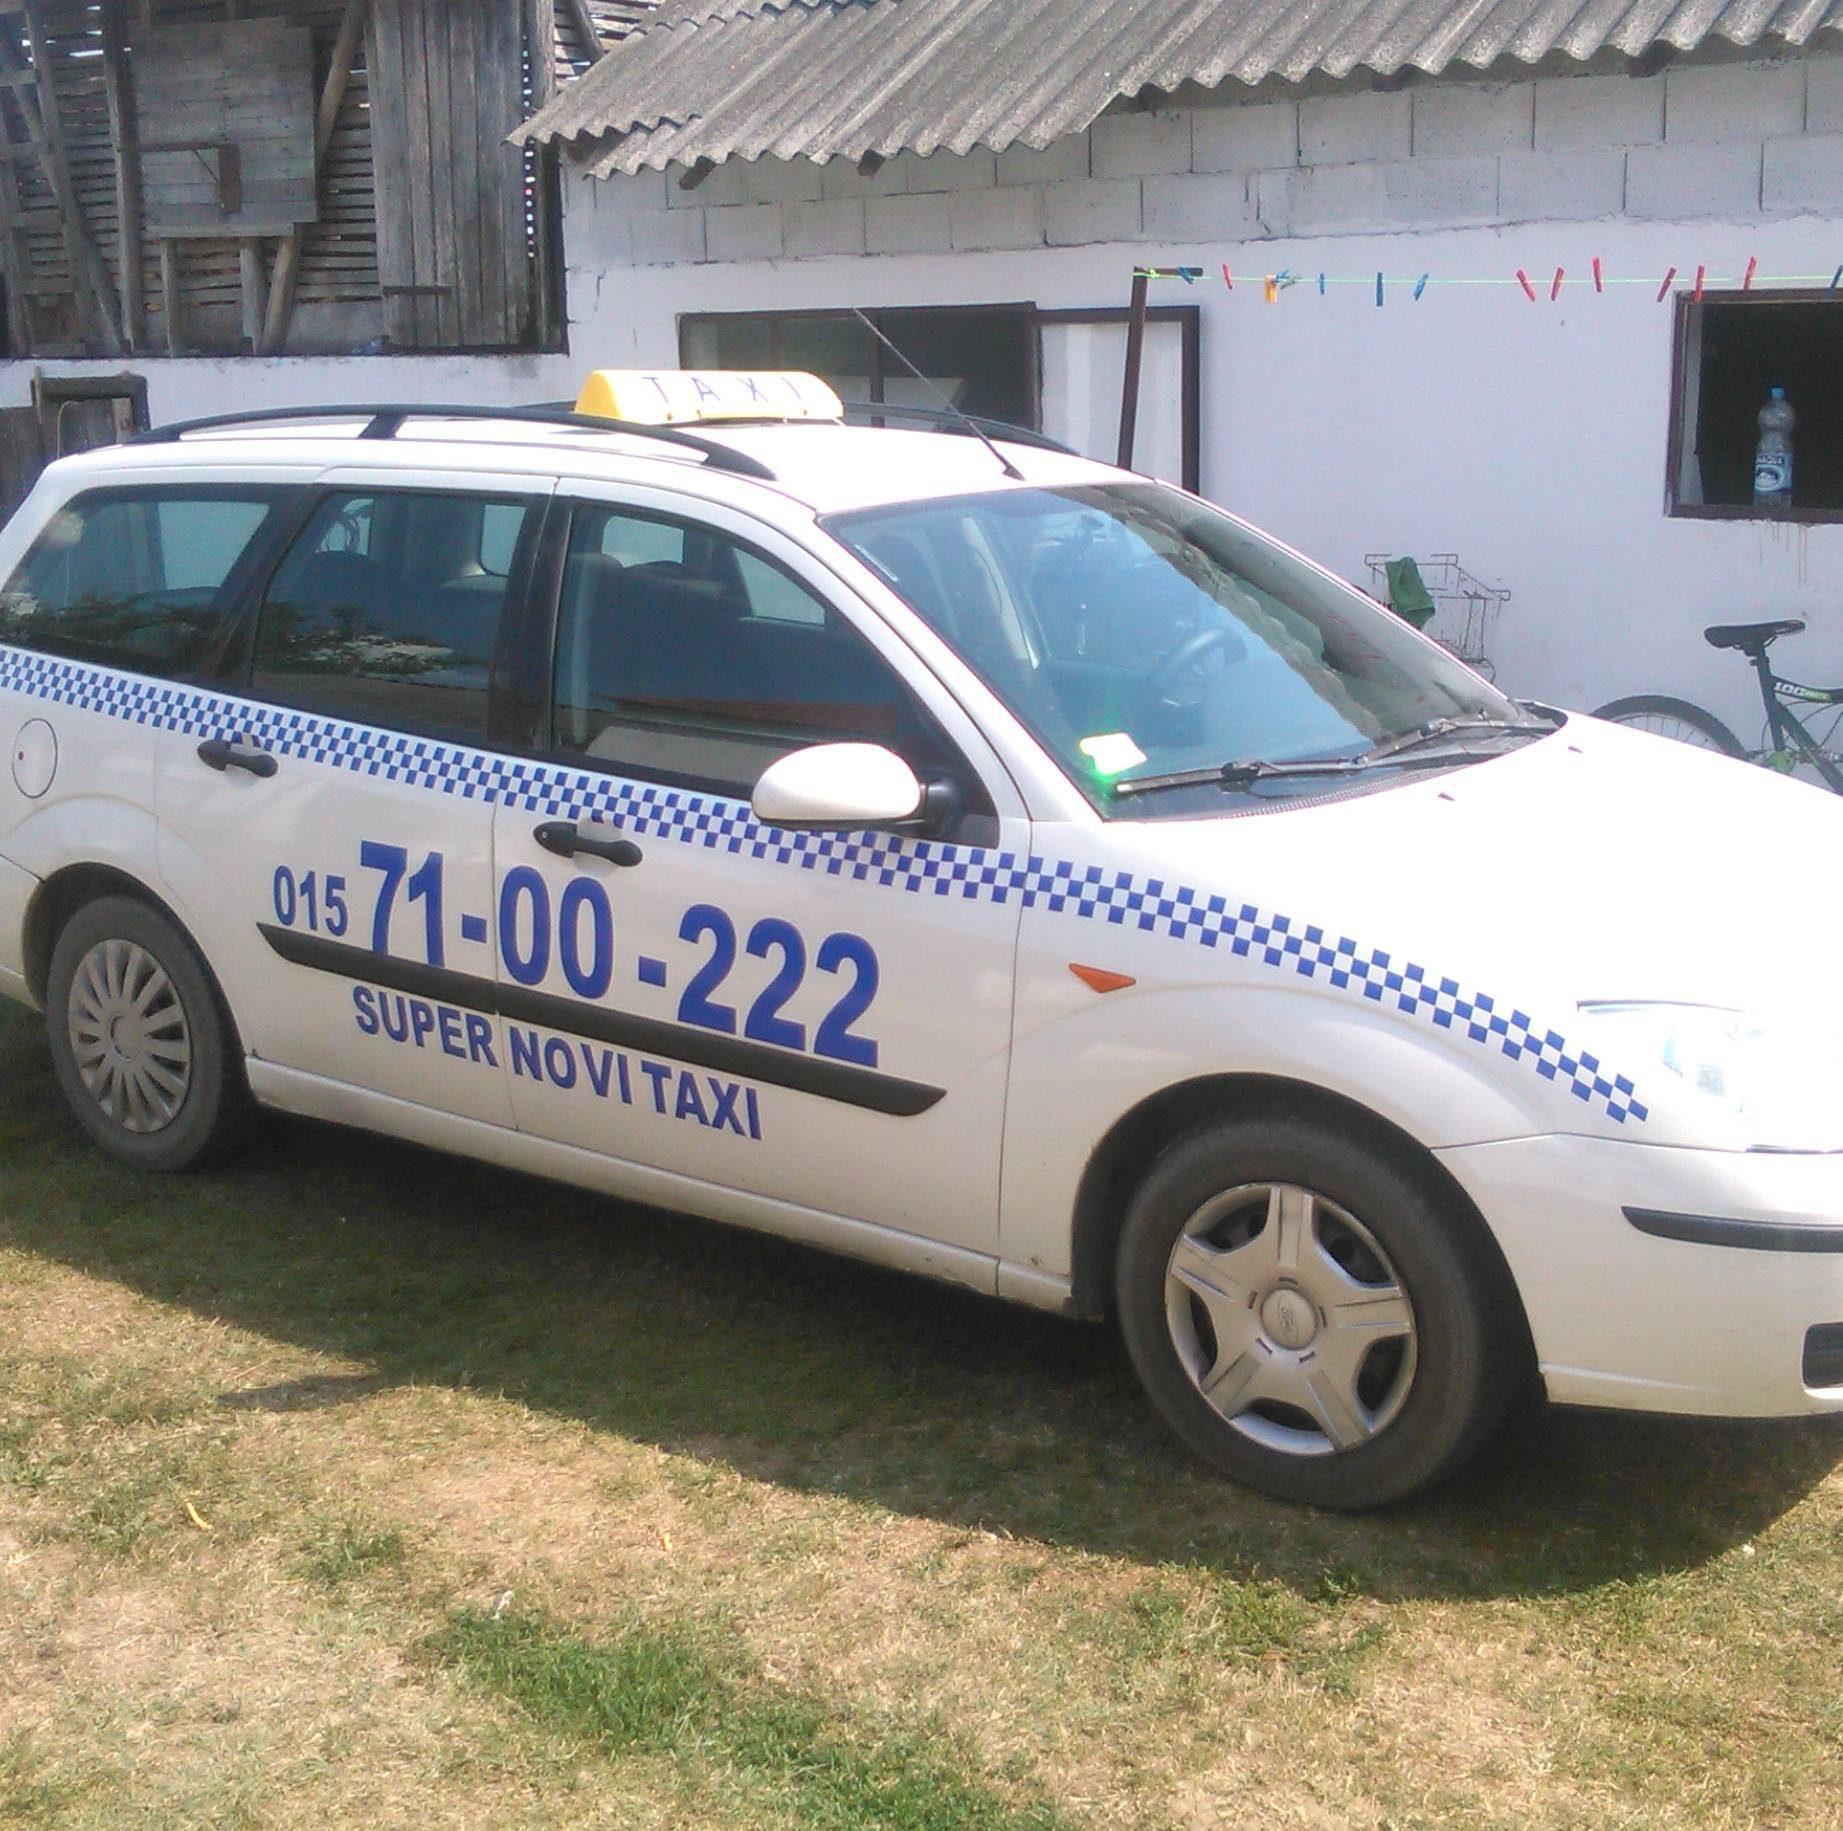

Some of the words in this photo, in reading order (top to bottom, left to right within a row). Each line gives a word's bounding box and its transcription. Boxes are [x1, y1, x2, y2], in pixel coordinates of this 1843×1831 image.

[641, 376, 802, 404] TAXI
[273, 865, 347, 937] 015
[352, 985, 498, 1068] SUPER
[509, 1026, 633, 1105] NOVI
[641, 1059, 763, 1140] TAXI
